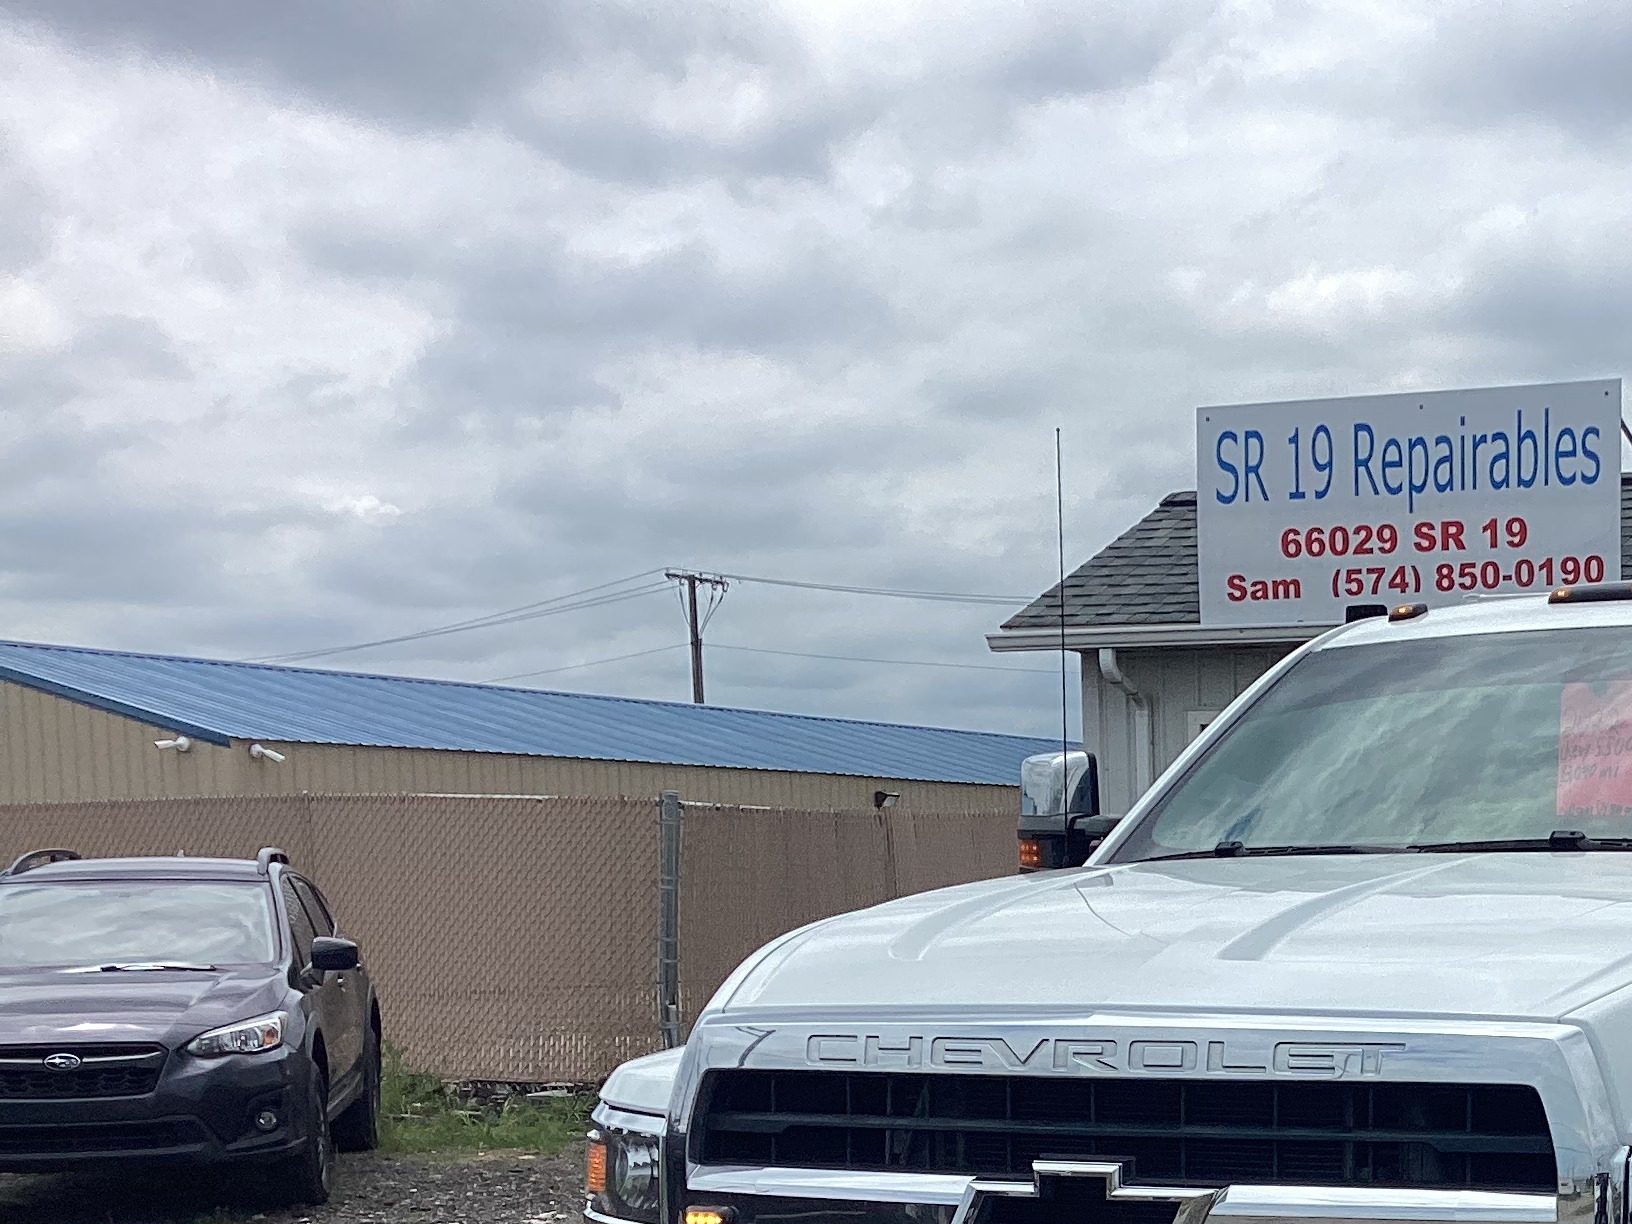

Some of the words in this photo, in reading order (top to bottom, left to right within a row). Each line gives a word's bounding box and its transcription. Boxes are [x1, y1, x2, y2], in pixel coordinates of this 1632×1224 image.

[1215, 430, 1269, 505] SR
[1288, 424, 1334, 501] 19
[1353, 408, 1601, 513] Repairables
[1280, 523, 1399, 559] 66029
[1413, 520, 1466, 553] SR
[1482, 517, 1529, 549] 19
[1227, 574, 1302, 602] Sam
[1332, 565, 1422, 598] (574)
[1435, 554, 1605, 592] 850-0190
[805, 1034, 1408, 1080] CHEVROLET
